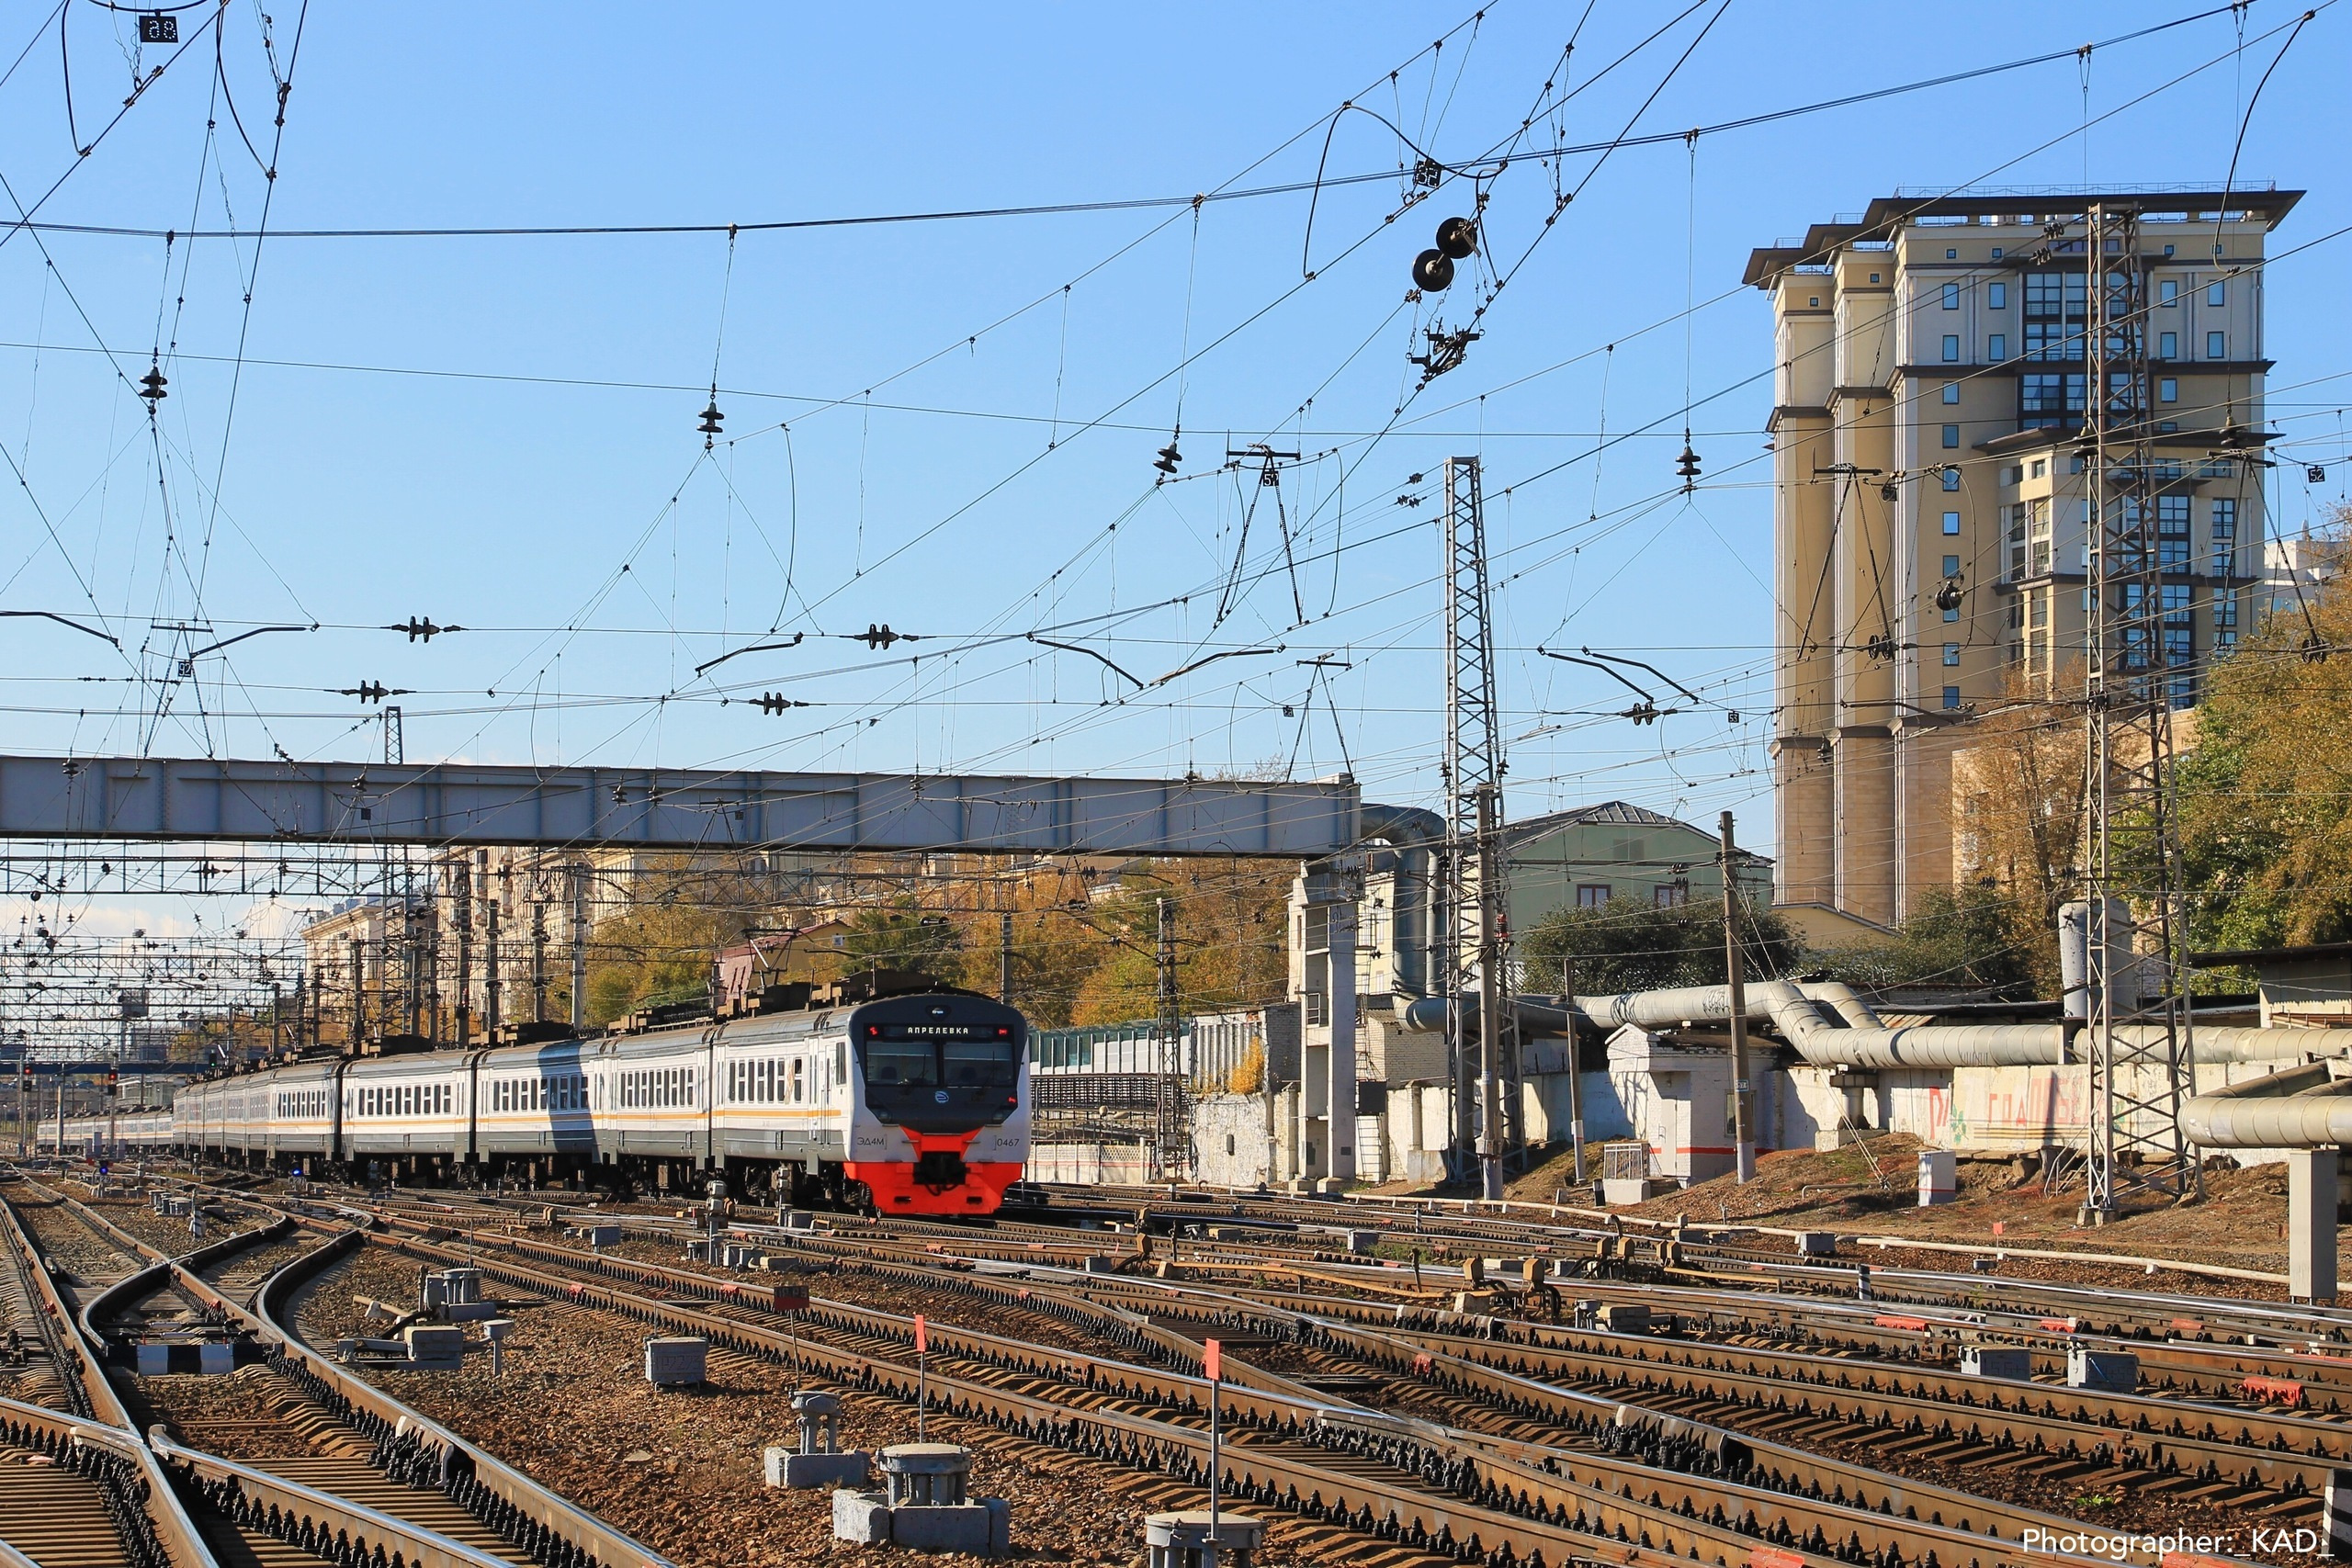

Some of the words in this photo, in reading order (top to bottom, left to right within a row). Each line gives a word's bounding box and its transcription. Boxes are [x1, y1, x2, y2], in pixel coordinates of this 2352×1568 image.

[2310, 468, 2324, 482] 52
[179, 662, 191, 677] 92
[1729, 714, 1738, 722] 53
[856, 1136, 885, 1145] ЭД4М
[997, 1138, 1020, 1147] 0467
